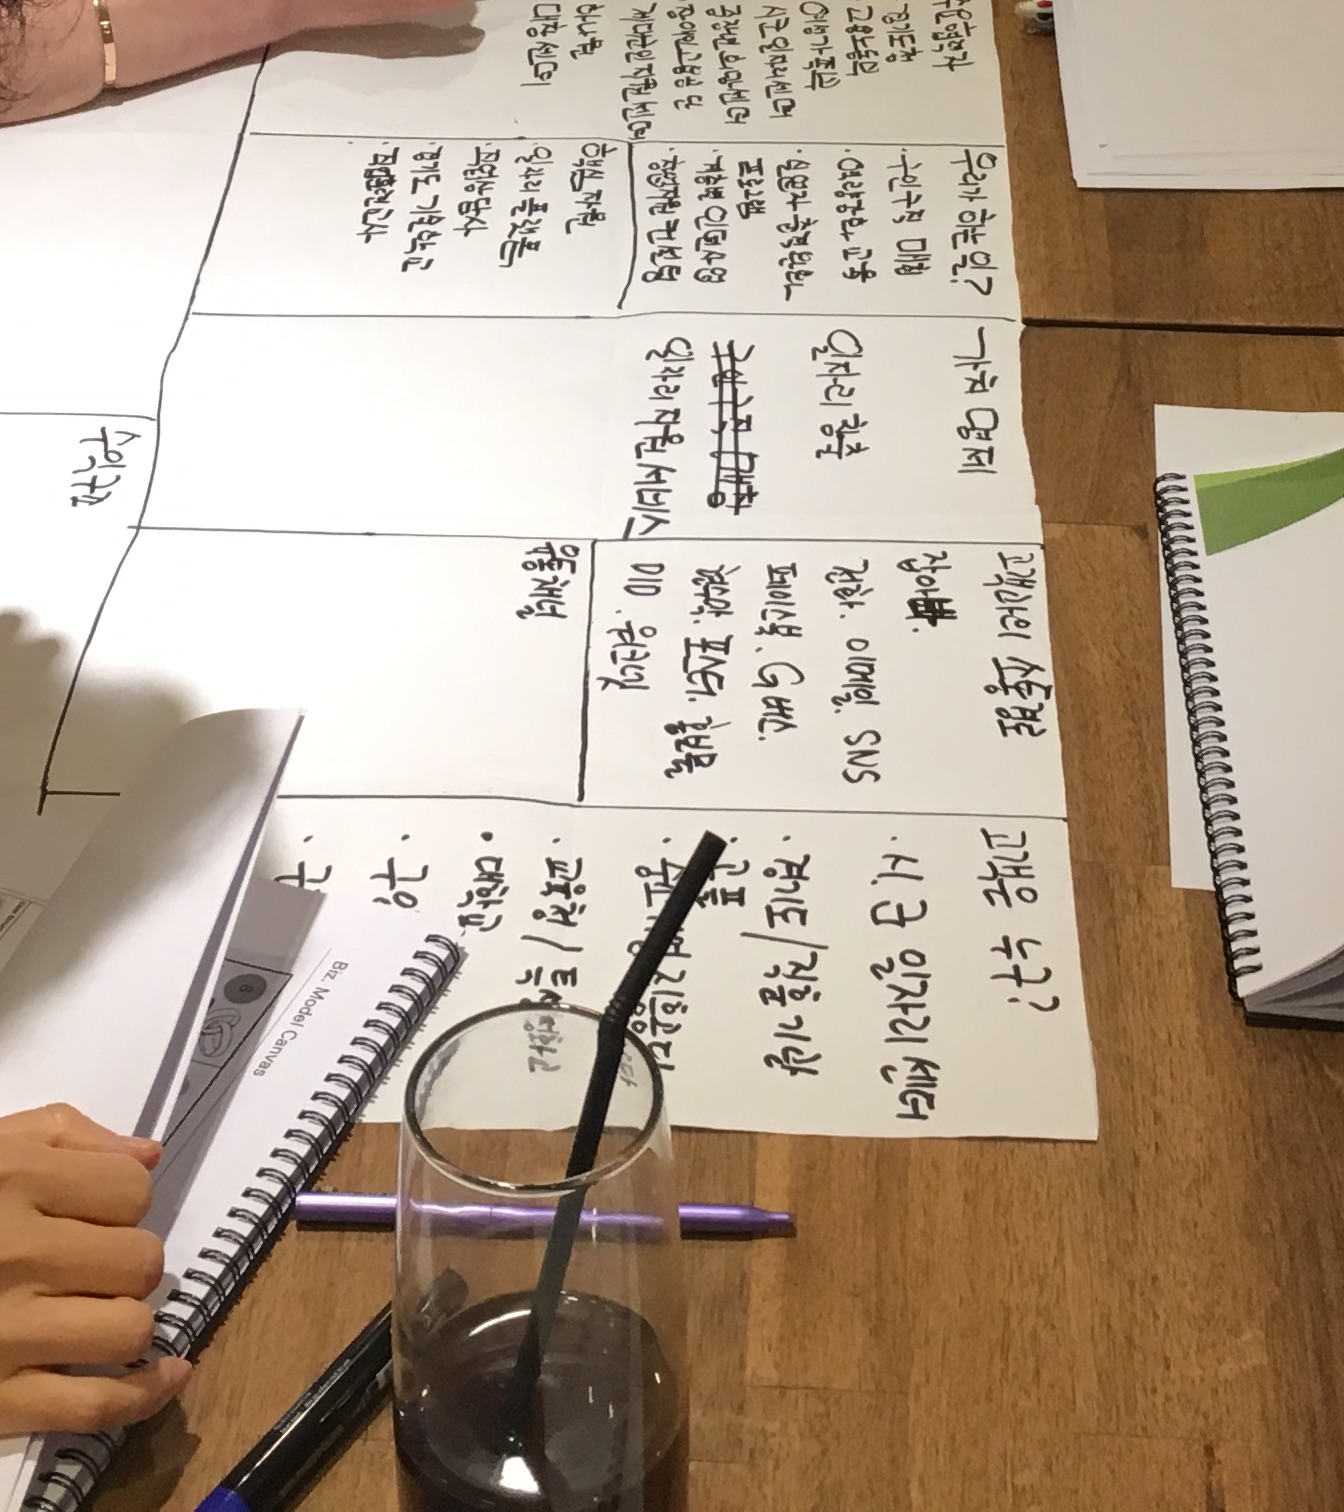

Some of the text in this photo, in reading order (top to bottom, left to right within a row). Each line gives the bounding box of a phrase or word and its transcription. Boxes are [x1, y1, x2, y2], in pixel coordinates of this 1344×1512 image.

[514, 146, 554, 193] 일자리
[736, 157, 766, 220] 프로그램
[887, 154, 925, 224] 구인구직
[949, 149, 997, 204] 우리가
[834, 157, 877, 283] 역량강화 교육
[645, 337, 695, 401] 일자리
[811, 328, 870, 460] 일자리 창출
[952, 326, 999, 475] 가치 명제
[621, 462, 678, 542] 서비스
[982, 551, 1038, 640] 고객과의
[843, 729, 882, 784] SNS
[532, 857, 586, 927] 교육청
[977, 827, 1060, 1012] 고객은 누구?
[252, 960, 349, 1078] Biz. Model Canvas
[869, 949, 932, 1044] 일자리
[880, 1056, 940, 1120] 센터
